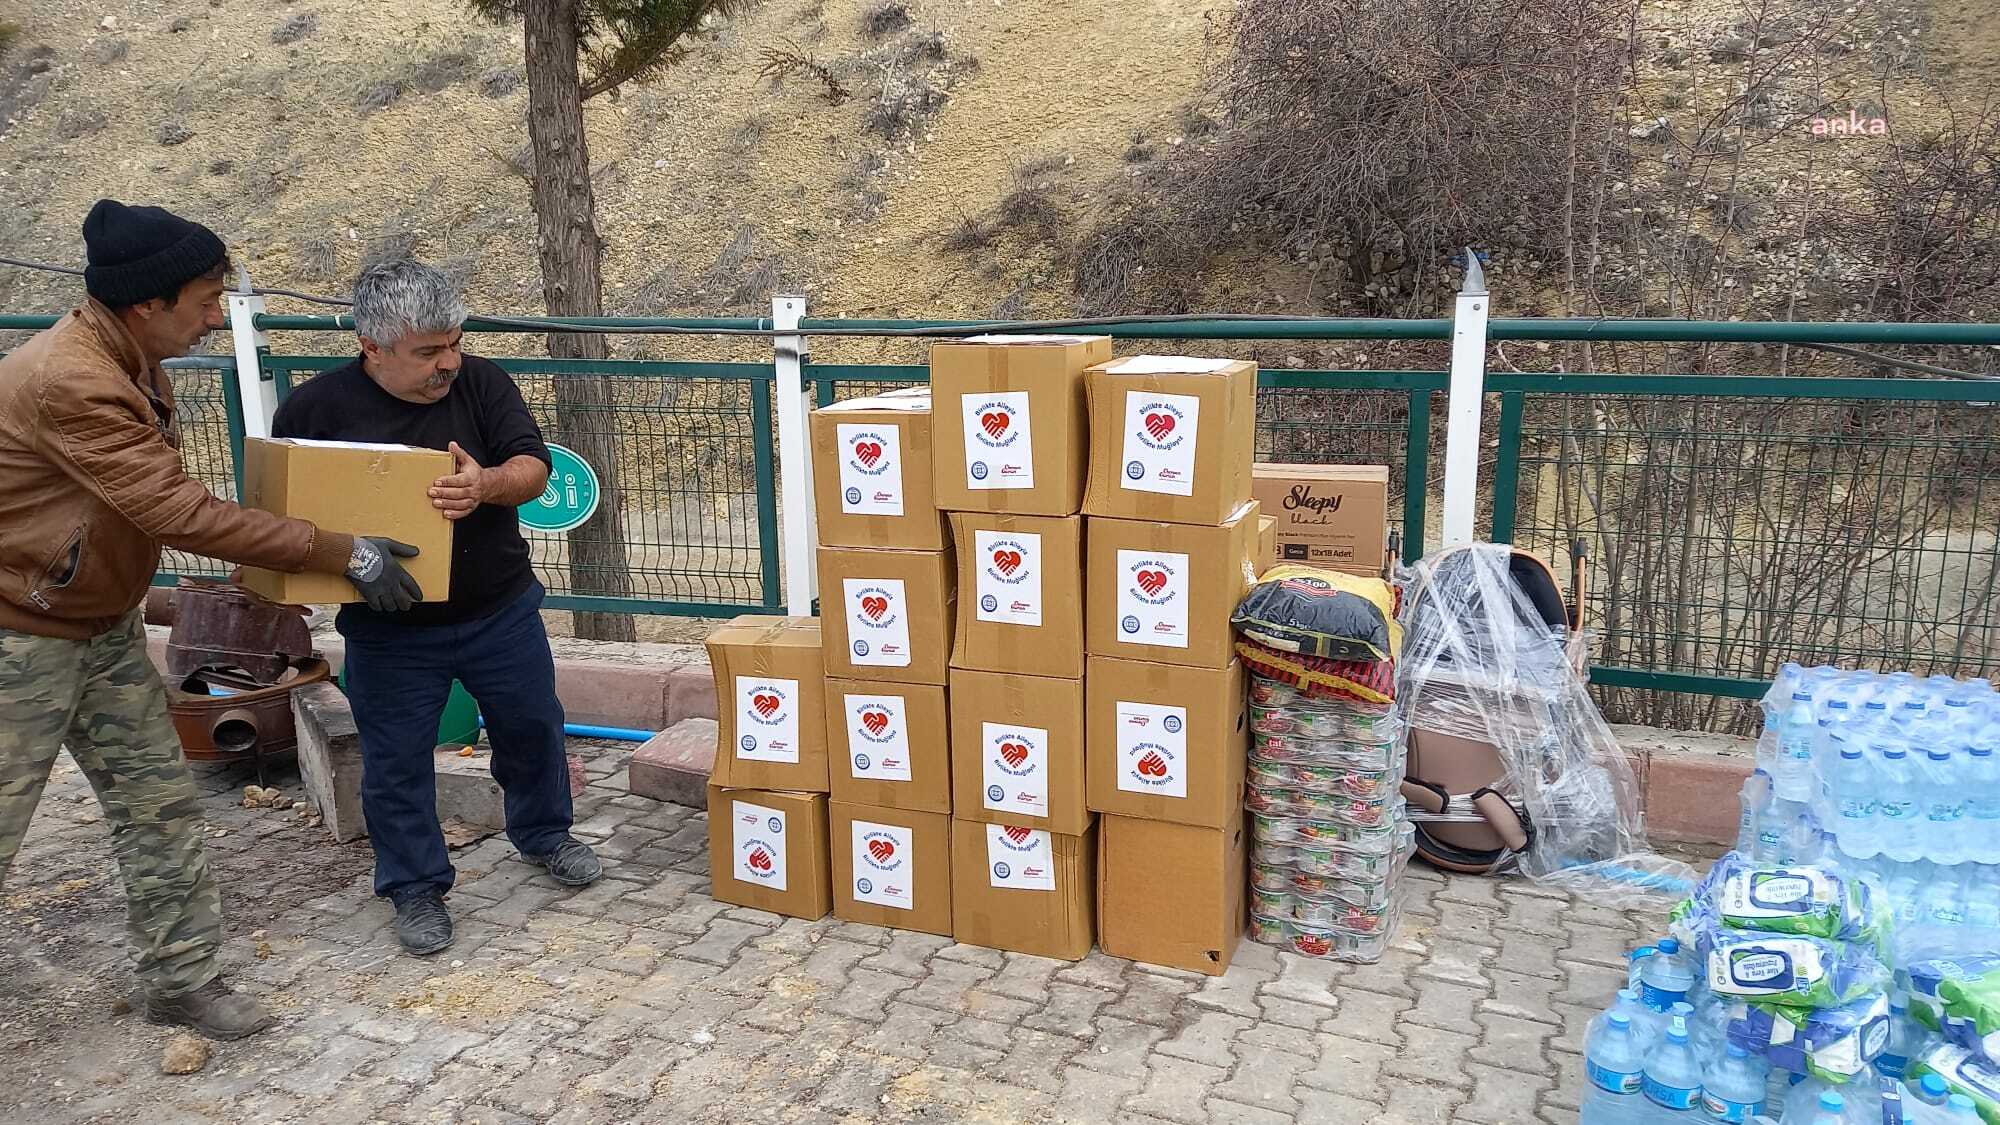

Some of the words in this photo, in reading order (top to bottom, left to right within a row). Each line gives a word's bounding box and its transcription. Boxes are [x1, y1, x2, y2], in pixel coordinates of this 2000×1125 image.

[975, 402, 995, 416] Birlikte
[1139, 403, 1162, 415] Birlikte
[1136, 432, 1155, 449] Birlikte
[1282, 484, 1343, 514] Sleepy
[1311, 549, 1332, 557] 12x18
[1130, 560, 1152, 572] Birlikte
